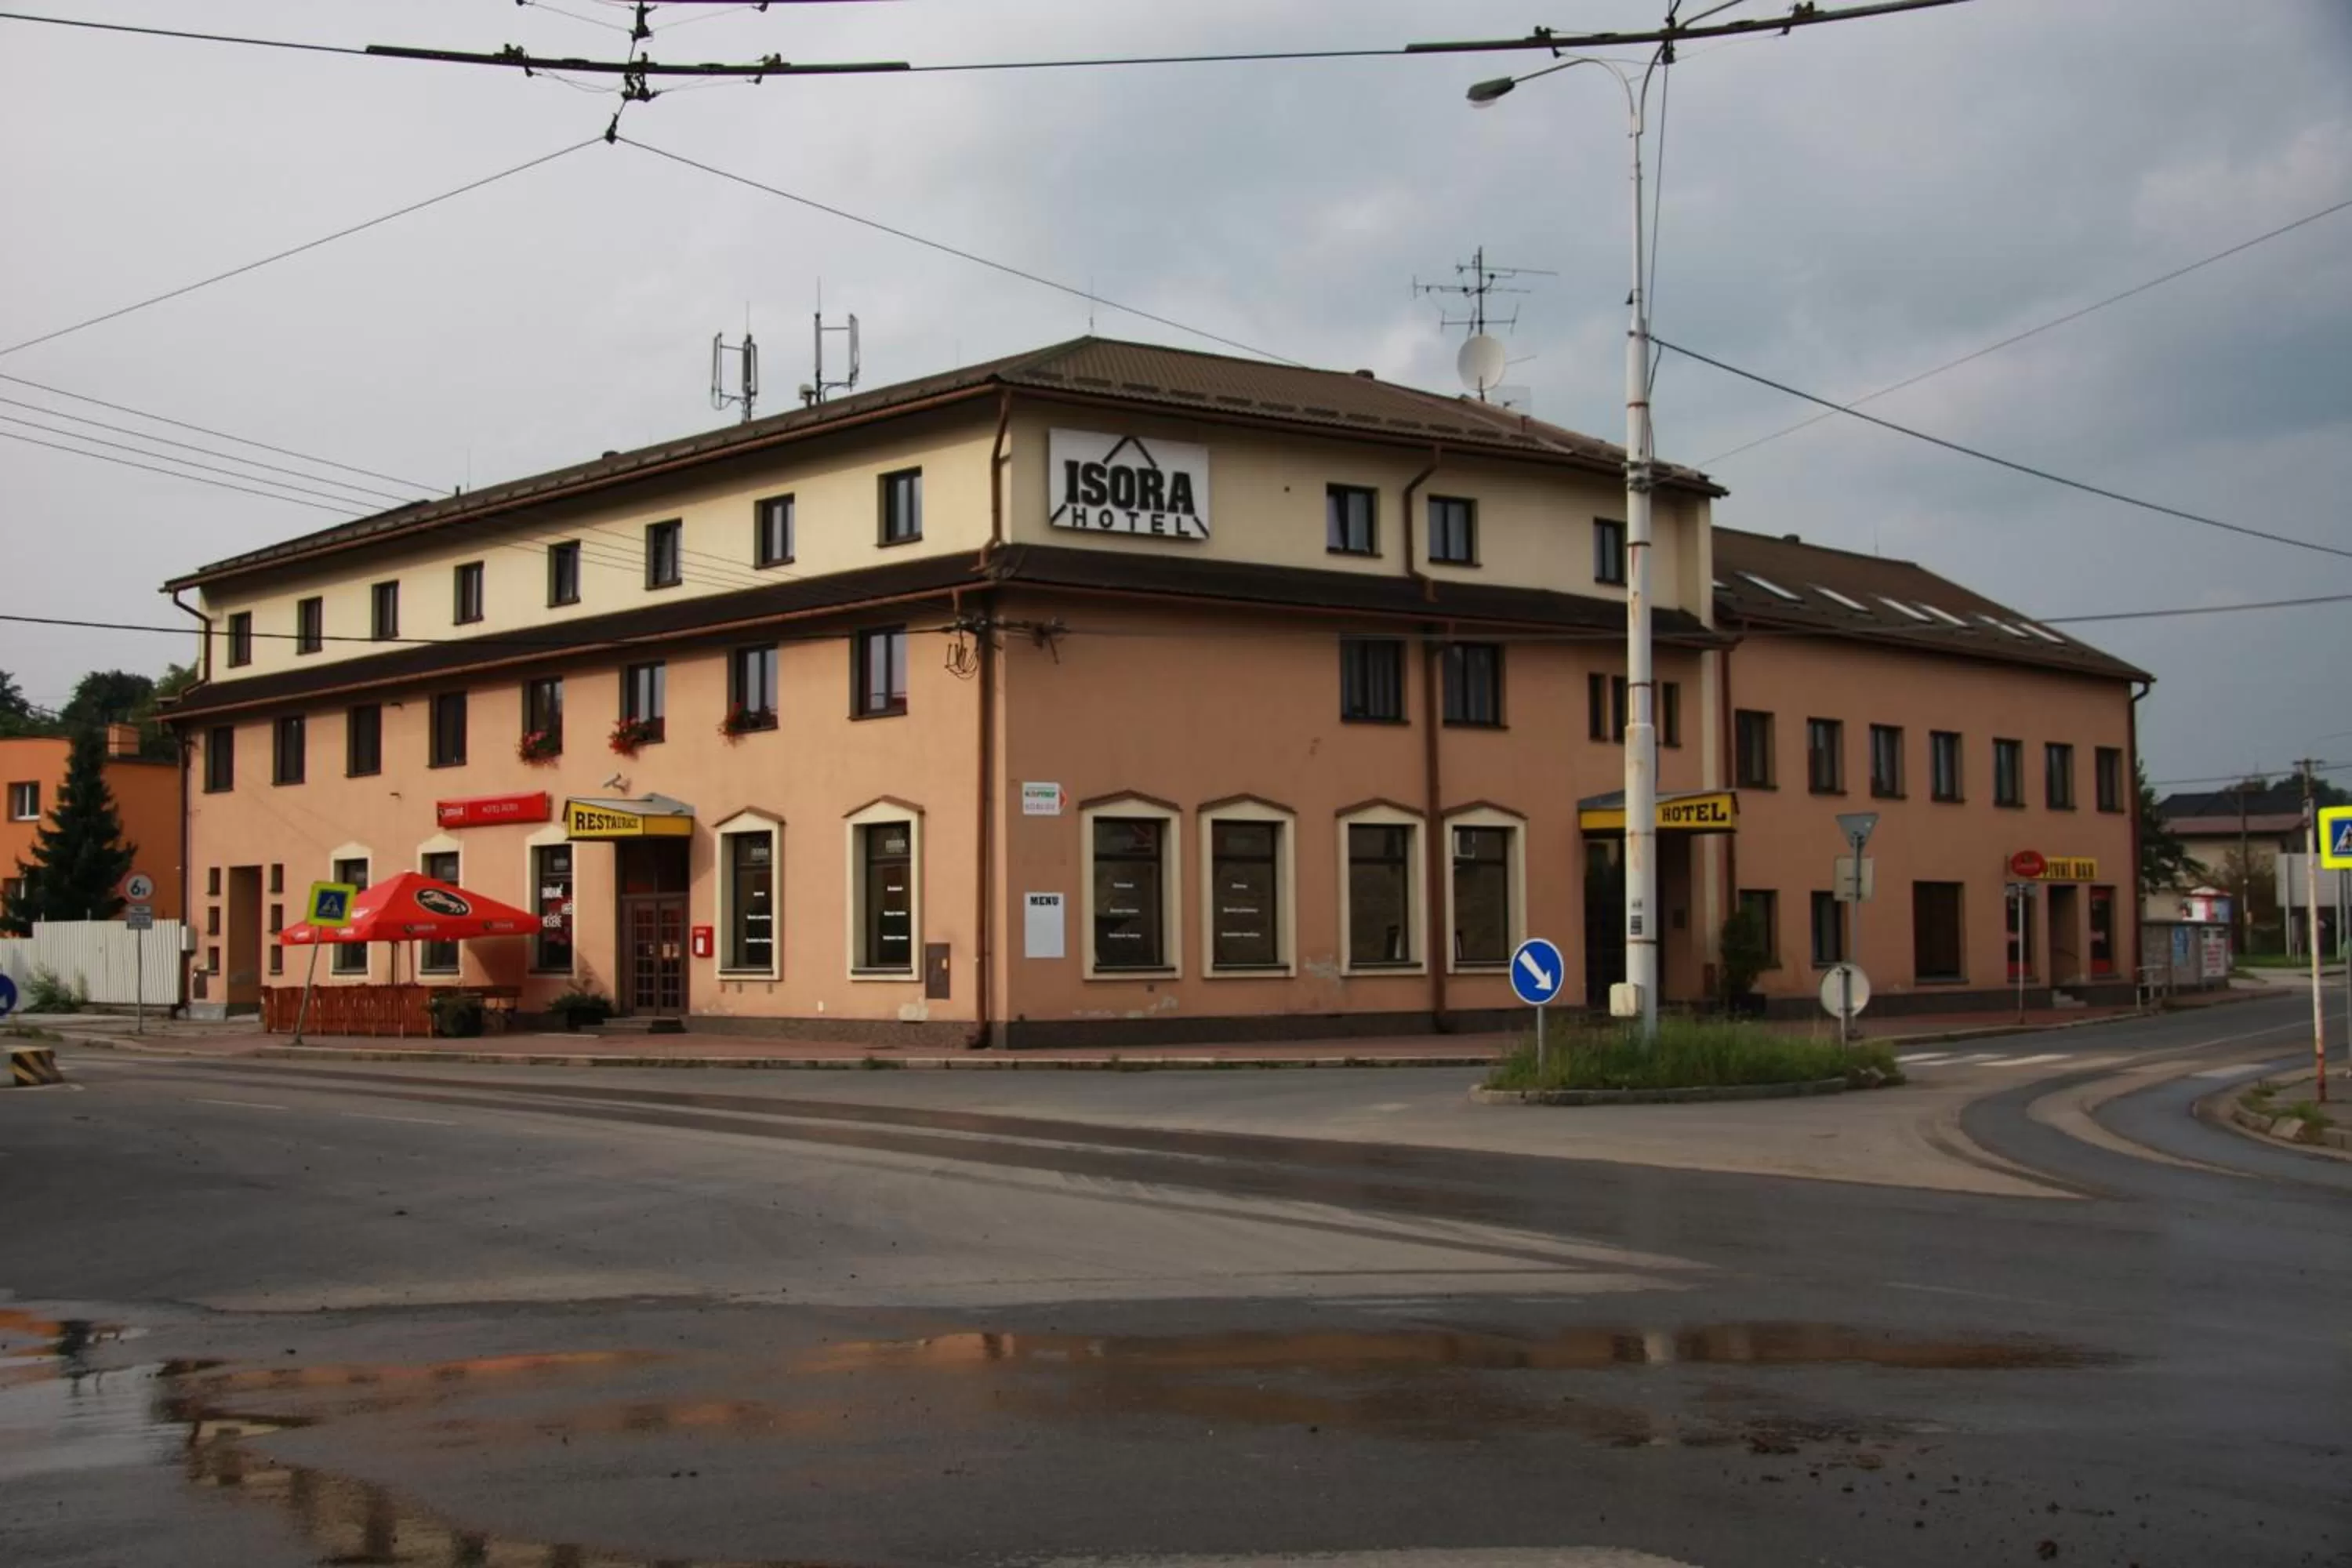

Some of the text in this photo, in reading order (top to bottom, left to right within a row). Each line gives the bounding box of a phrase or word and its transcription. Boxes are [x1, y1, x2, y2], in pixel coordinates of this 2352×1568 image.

[1064, 459, 1196, 515] ISORA
[1072, 506, 1190, 538] HOTEL
[1661, 802, 1727, 822] HOTEL
[1029, 895, 1059, 906] MENU
